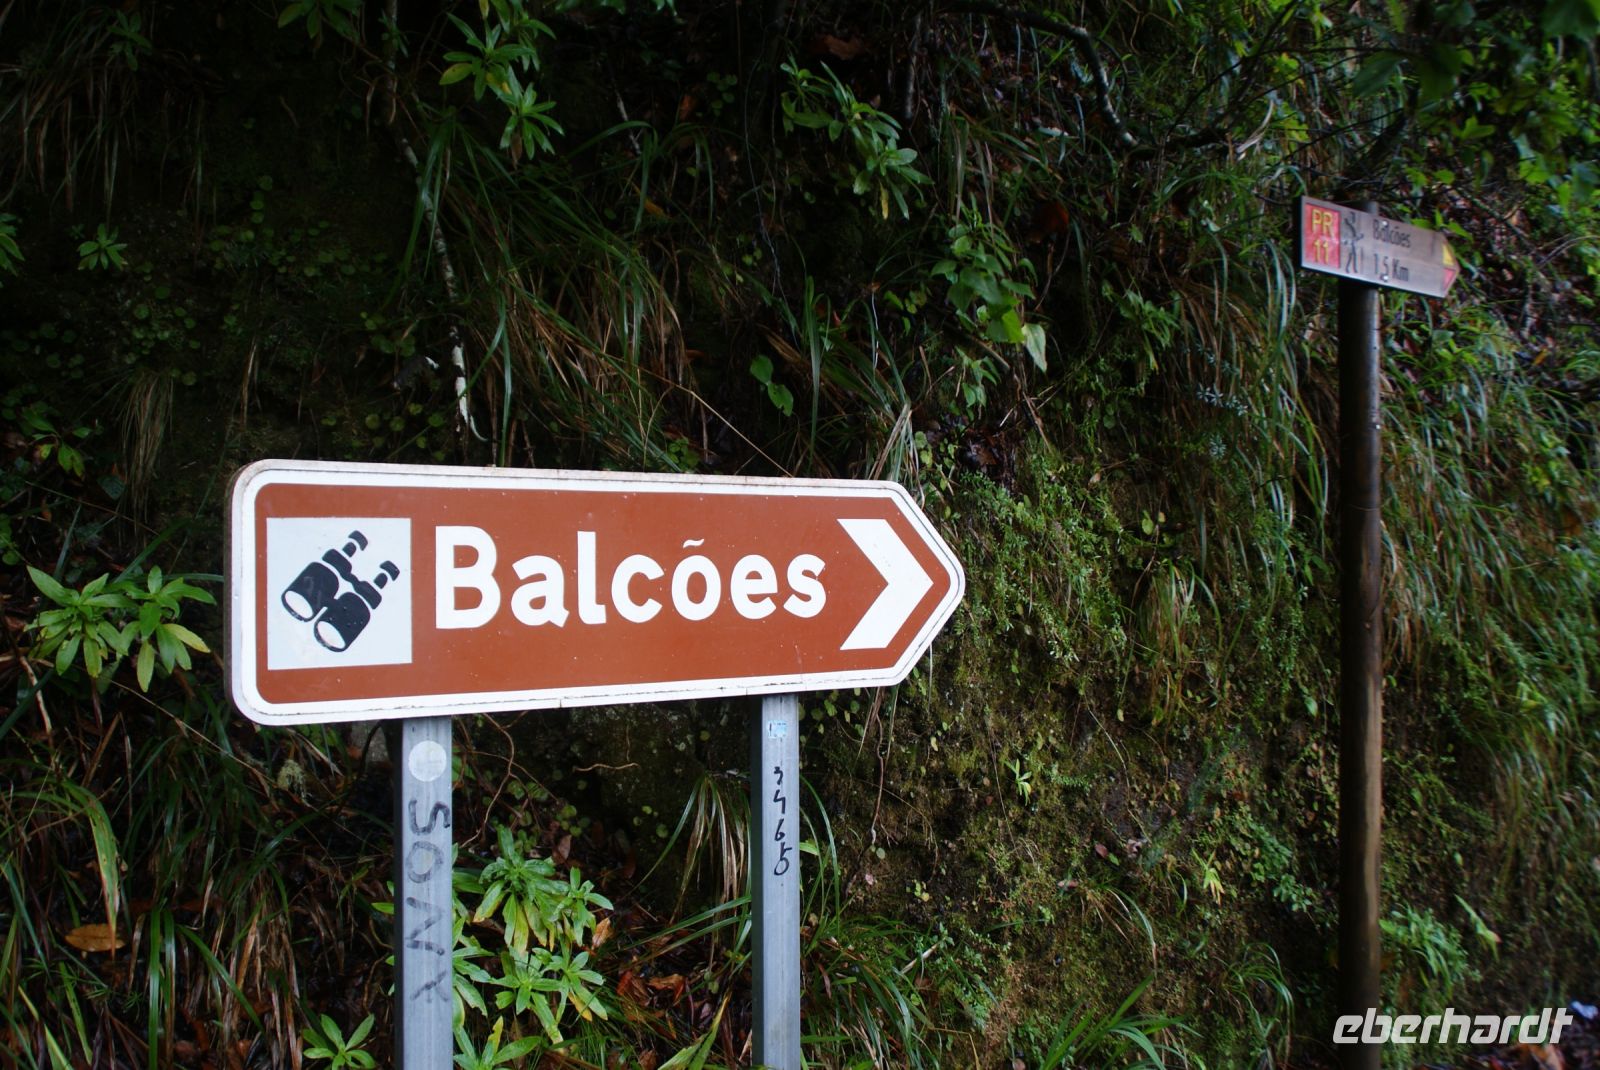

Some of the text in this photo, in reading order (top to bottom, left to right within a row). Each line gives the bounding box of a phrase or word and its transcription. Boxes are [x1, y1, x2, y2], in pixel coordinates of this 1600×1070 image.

[1312, 209, 1333, 239] PR
[1372, 218, 1411, 249] Balcões
[1313, 239, 1330, 265] 11
[1392, 257, 1409, 282] Km
[436, 525, 827, 629] Balcões
